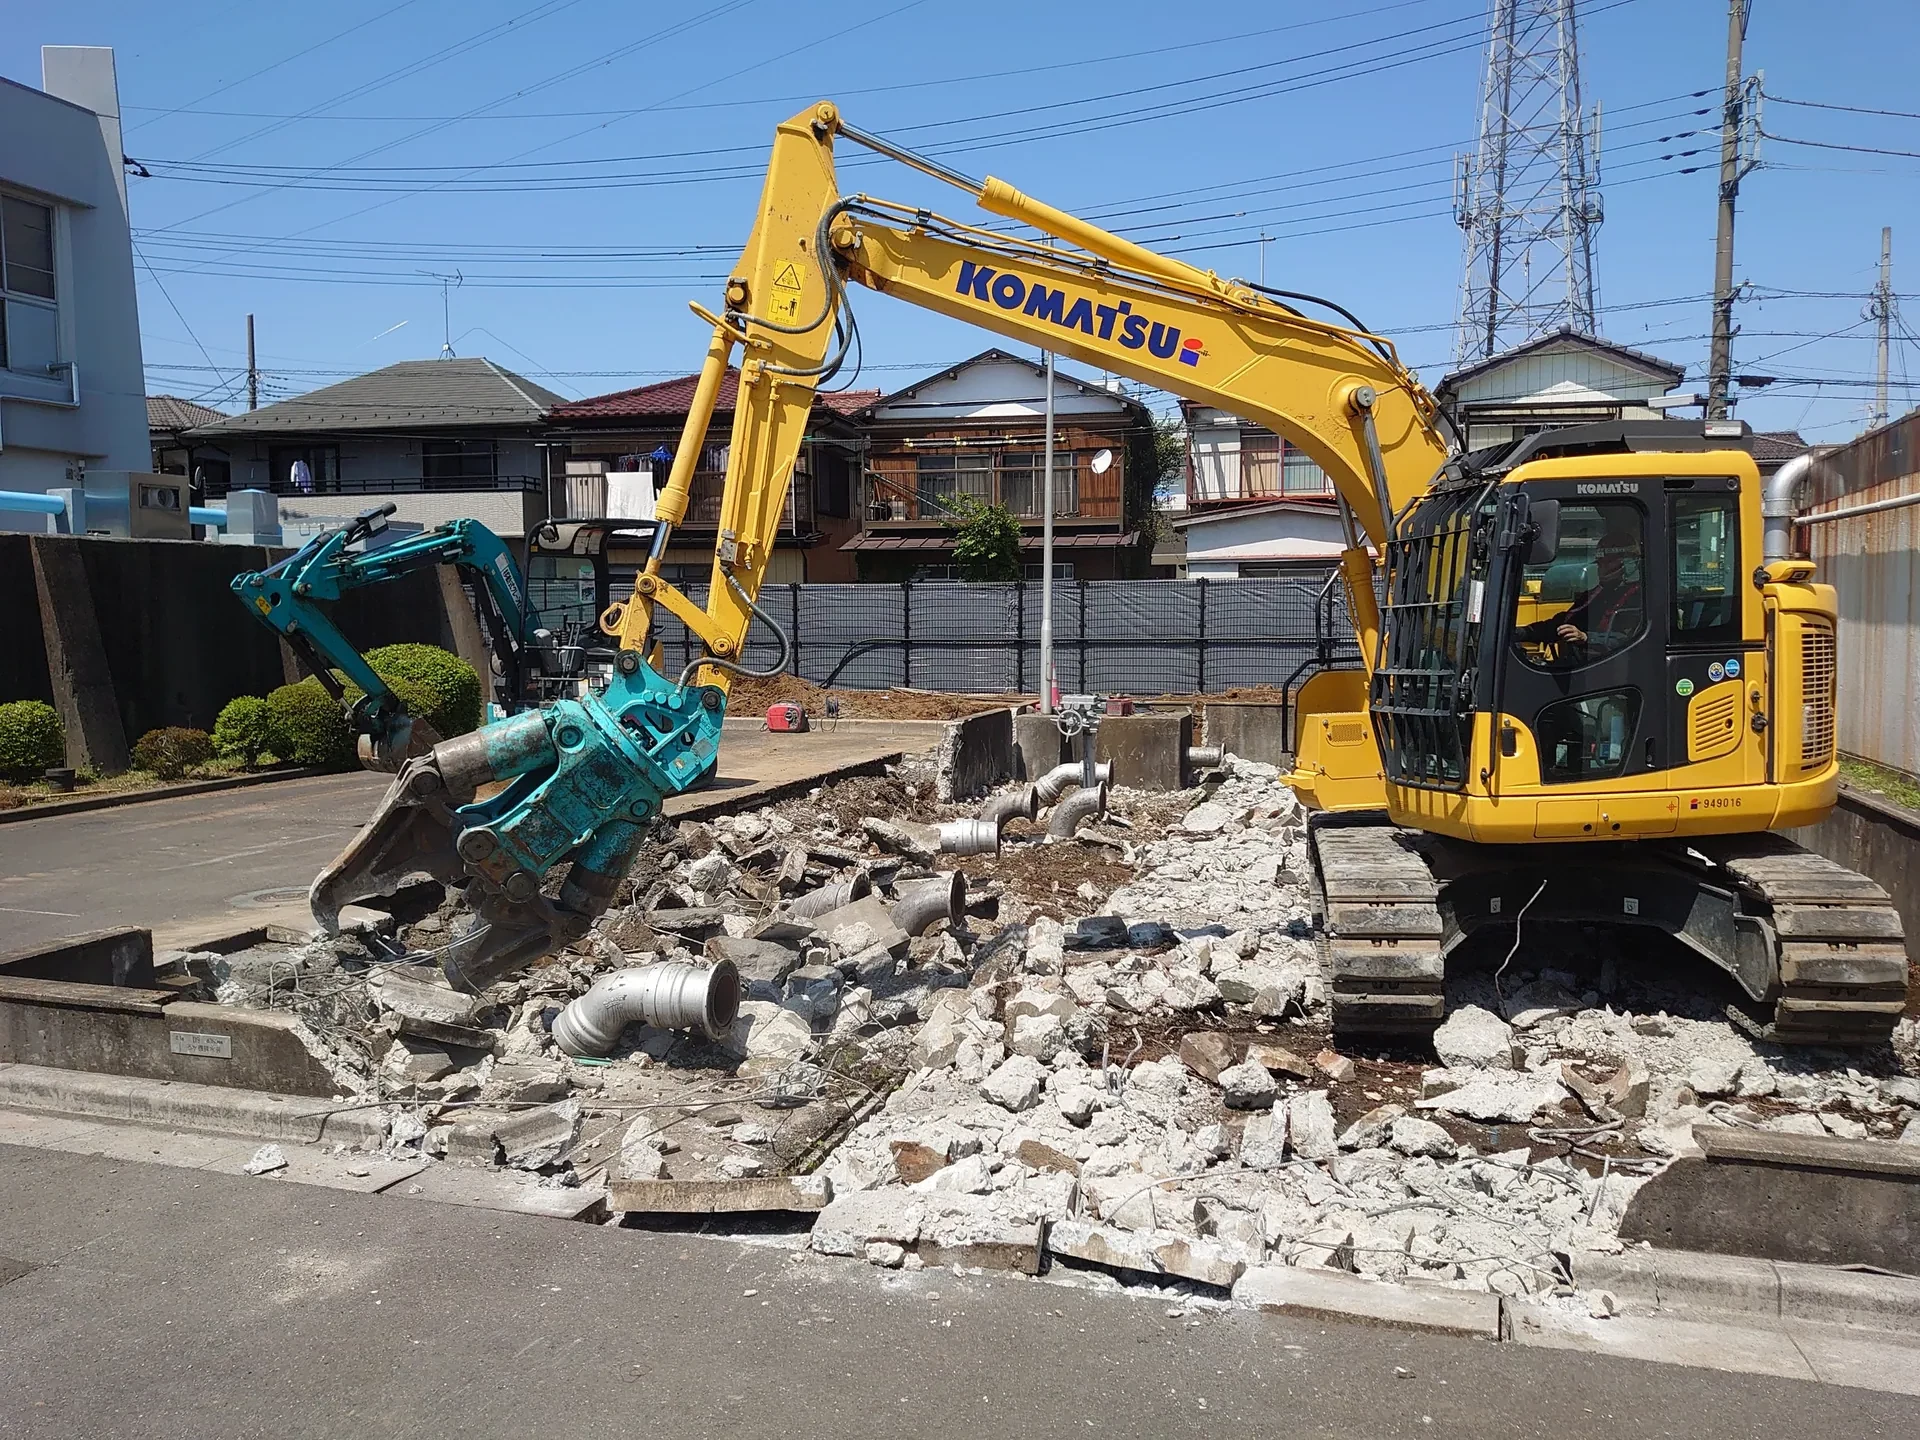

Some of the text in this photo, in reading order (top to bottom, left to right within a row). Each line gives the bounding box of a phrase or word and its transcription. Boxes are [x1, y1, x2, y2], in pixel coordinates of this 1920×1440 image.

[955, 260, 1181, 359] KOMATSU
[1577, 481, 1638, 494] KOMATSU
[1703, 798, 1742, 809] 949016
